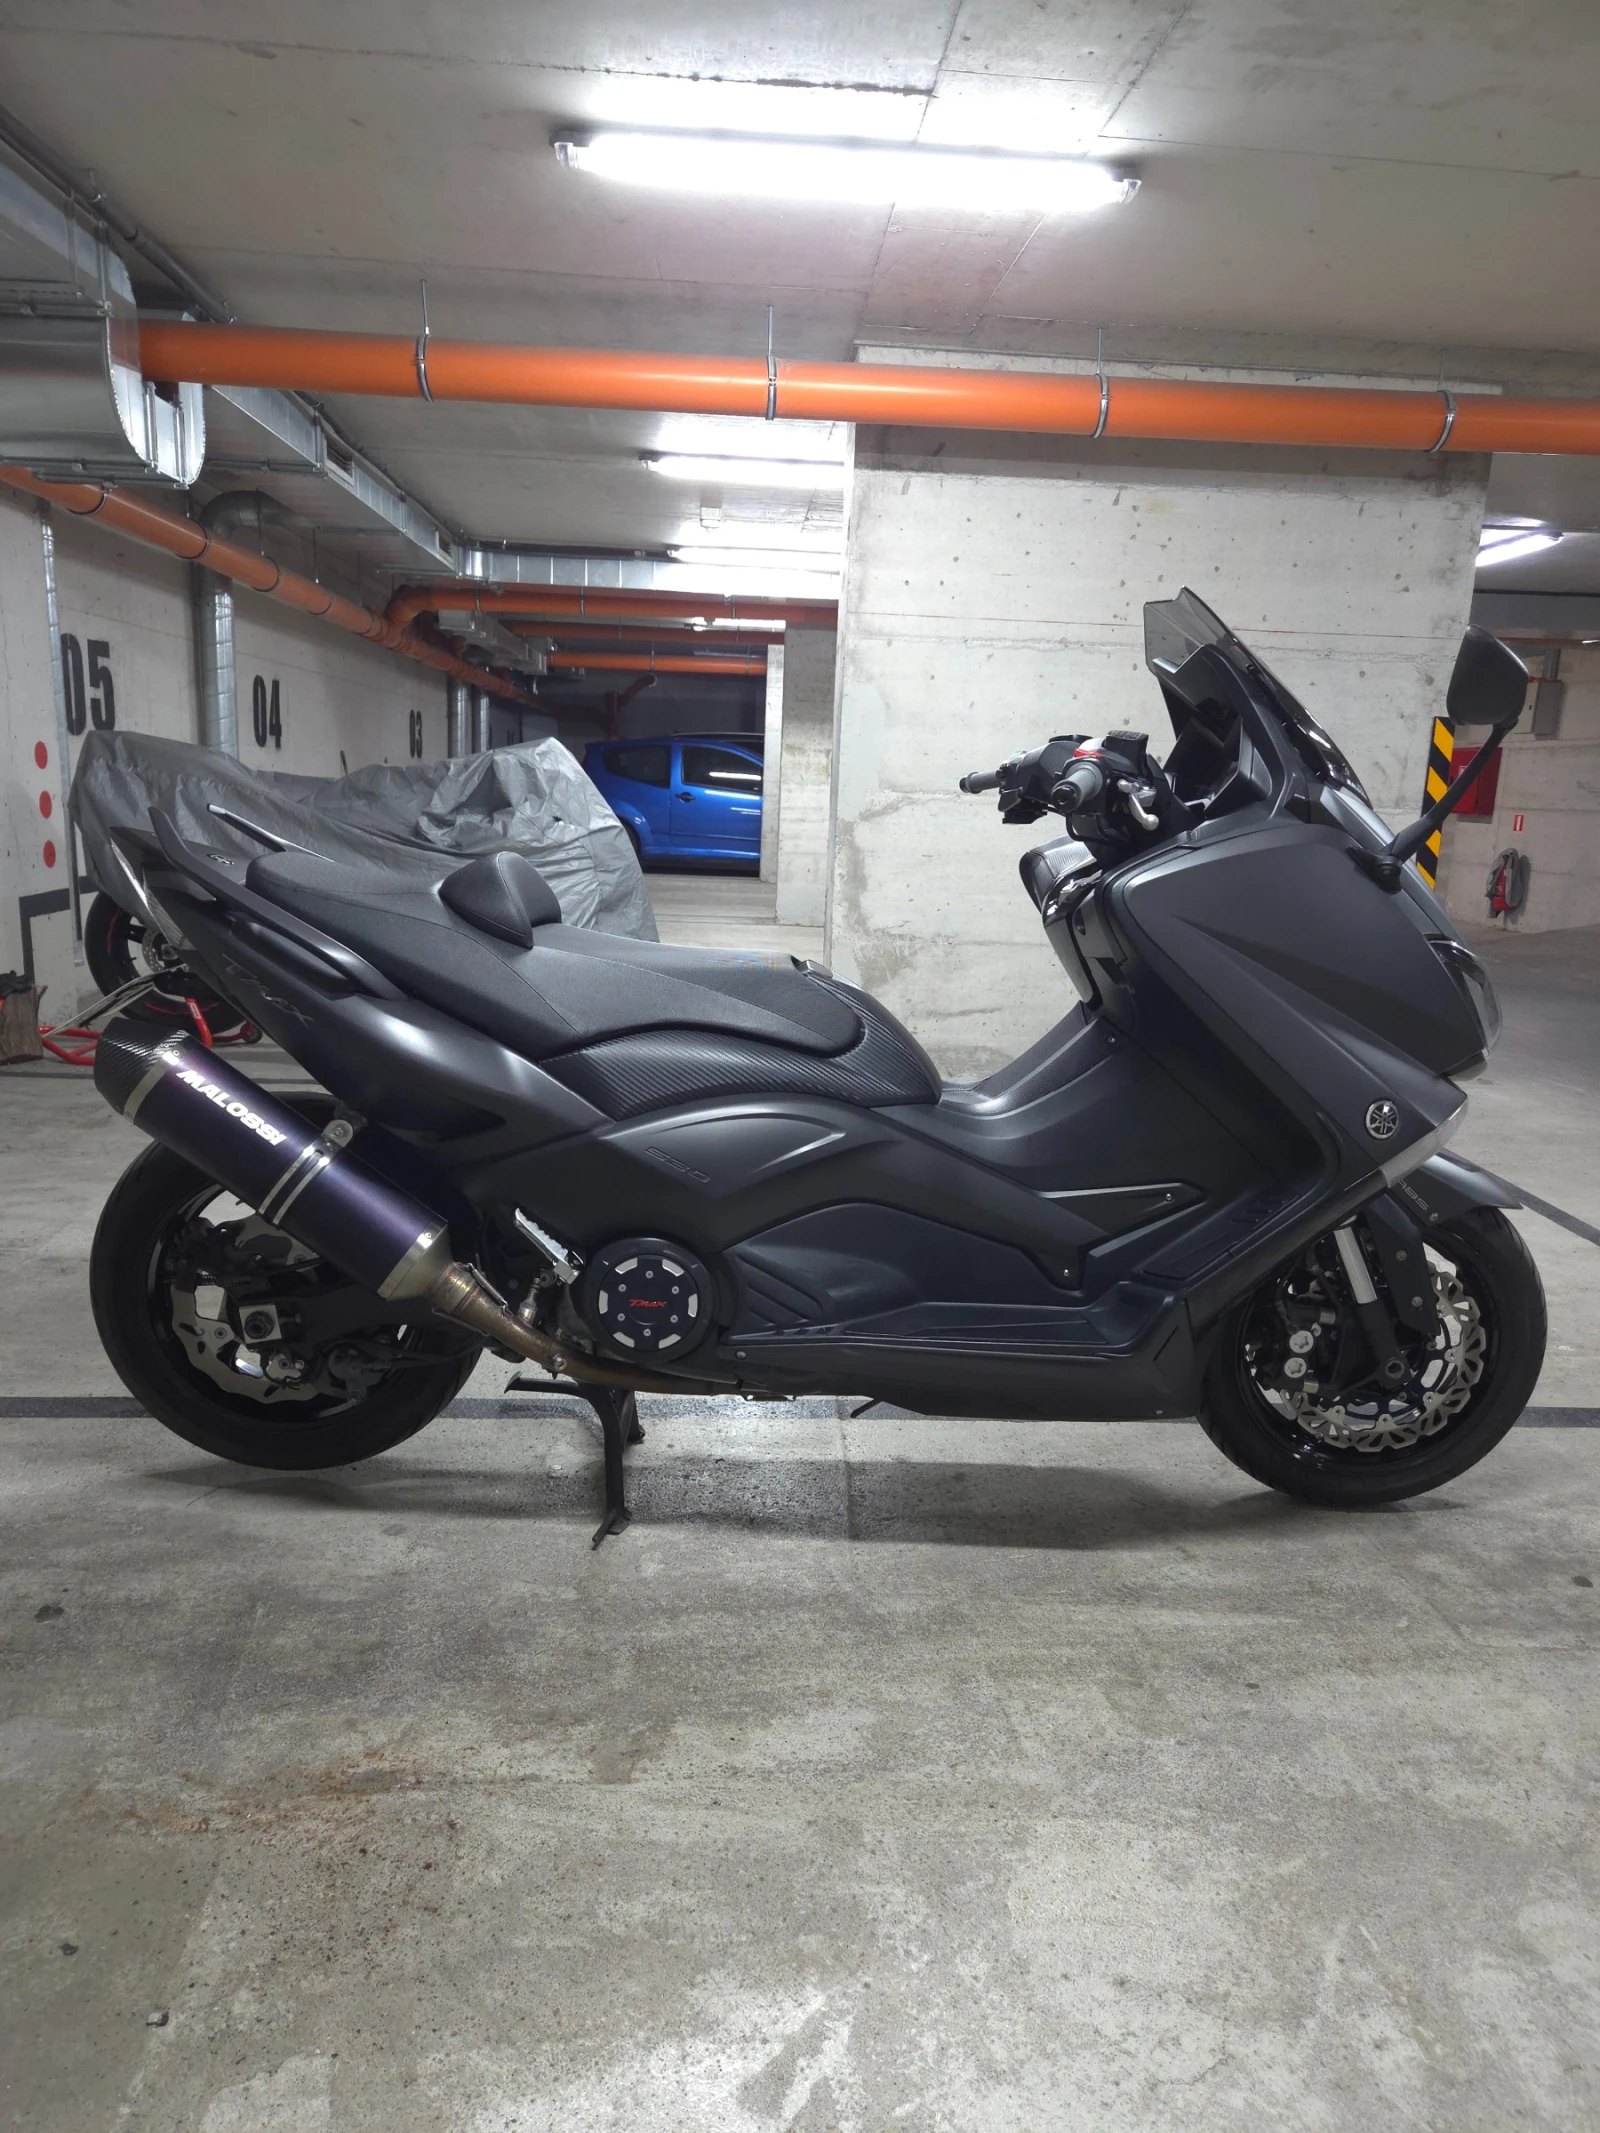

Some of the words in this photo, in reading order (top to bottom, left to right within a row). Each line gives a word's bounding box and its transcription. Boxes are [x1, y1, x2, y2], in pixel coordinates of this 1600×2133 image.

[60, 633, 116, 736] 05
[253, 674, 282, 749] 04
[409, 709, 423, 759] 03
[176, 1069, 288, 1146] MALOSSI
[644, 1147, 711, 1183] 530
